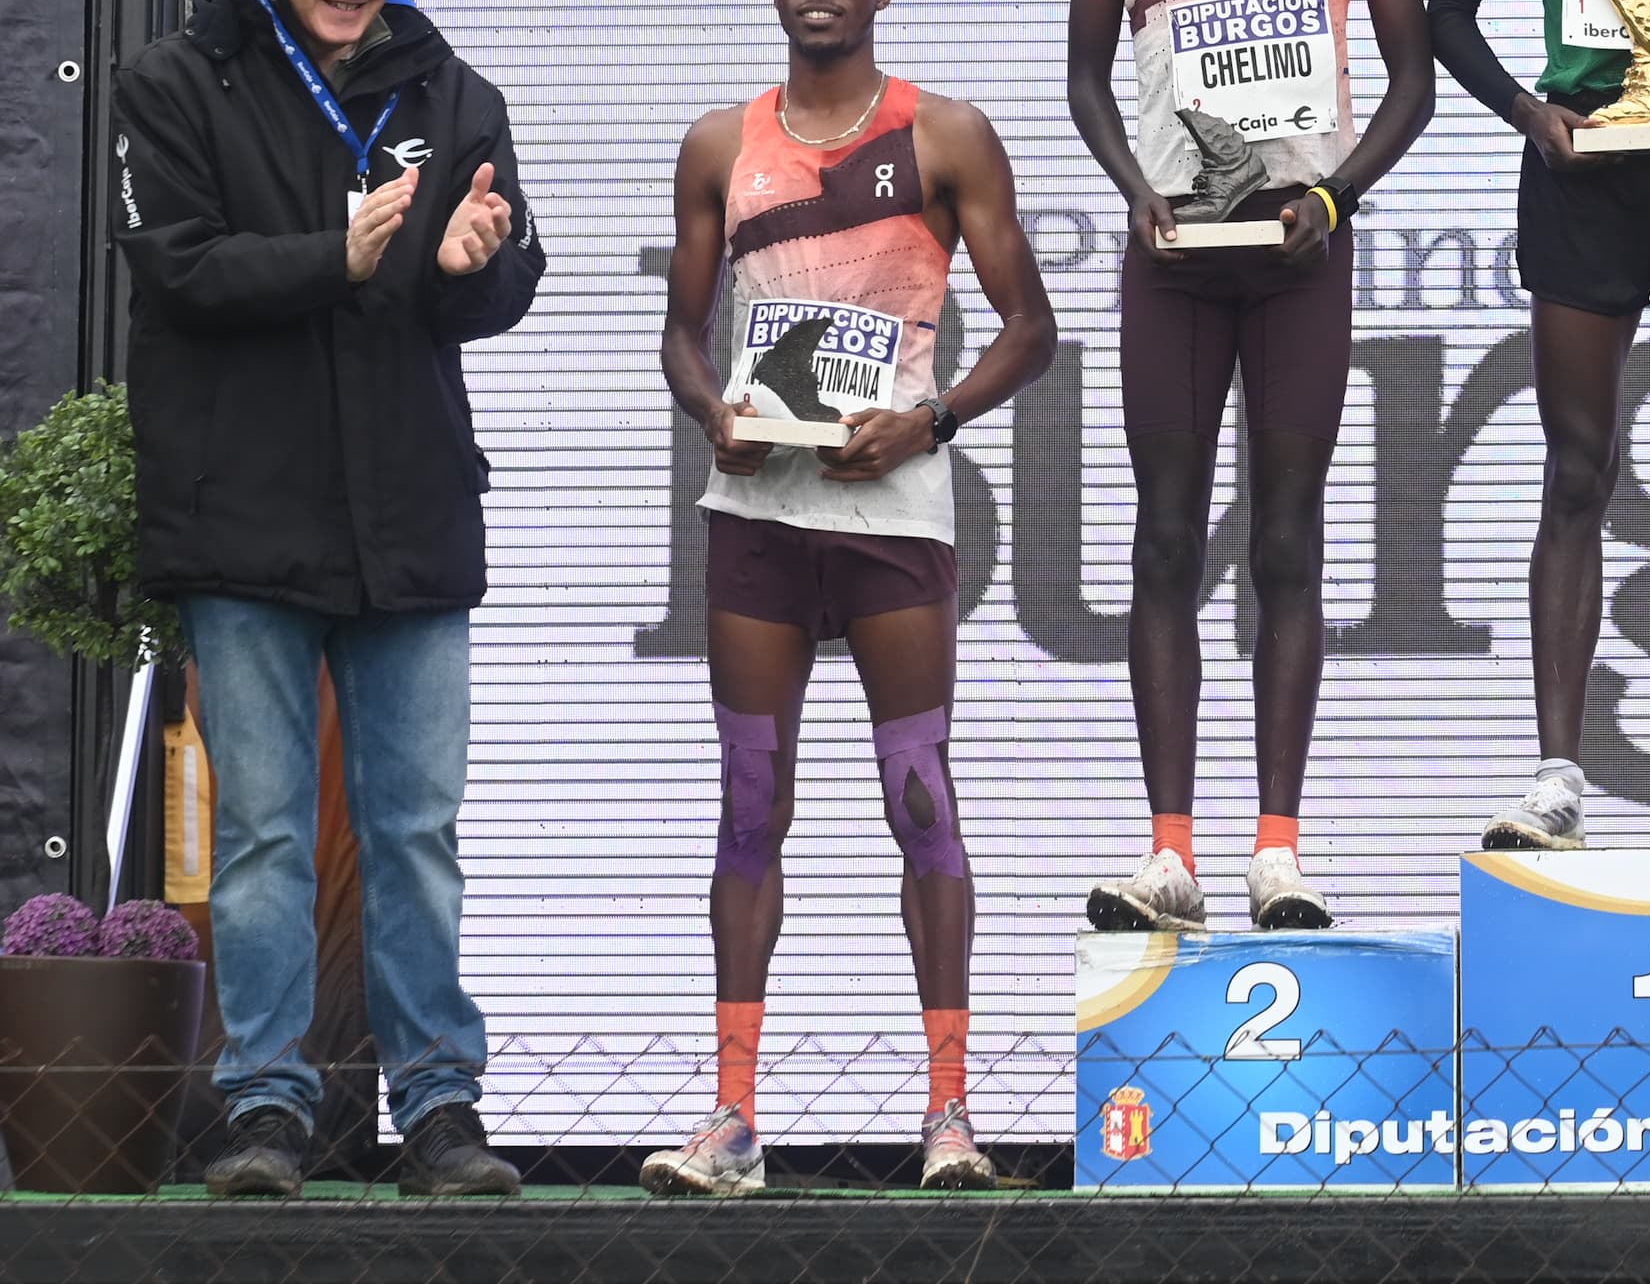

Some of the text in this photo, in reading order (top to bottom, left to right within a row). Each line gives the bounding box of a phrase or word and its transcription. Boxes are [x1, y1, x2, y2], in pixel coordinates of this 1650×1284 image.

[1180, 10, 1321, 50] BURGOS
[1583, 22, 1631, 39] iberC
[1200, 41, 1312, 89] CHELIMO
[752, 321, 891, 360] BUGOS
[1223, 961, 1302, 1061] 2
